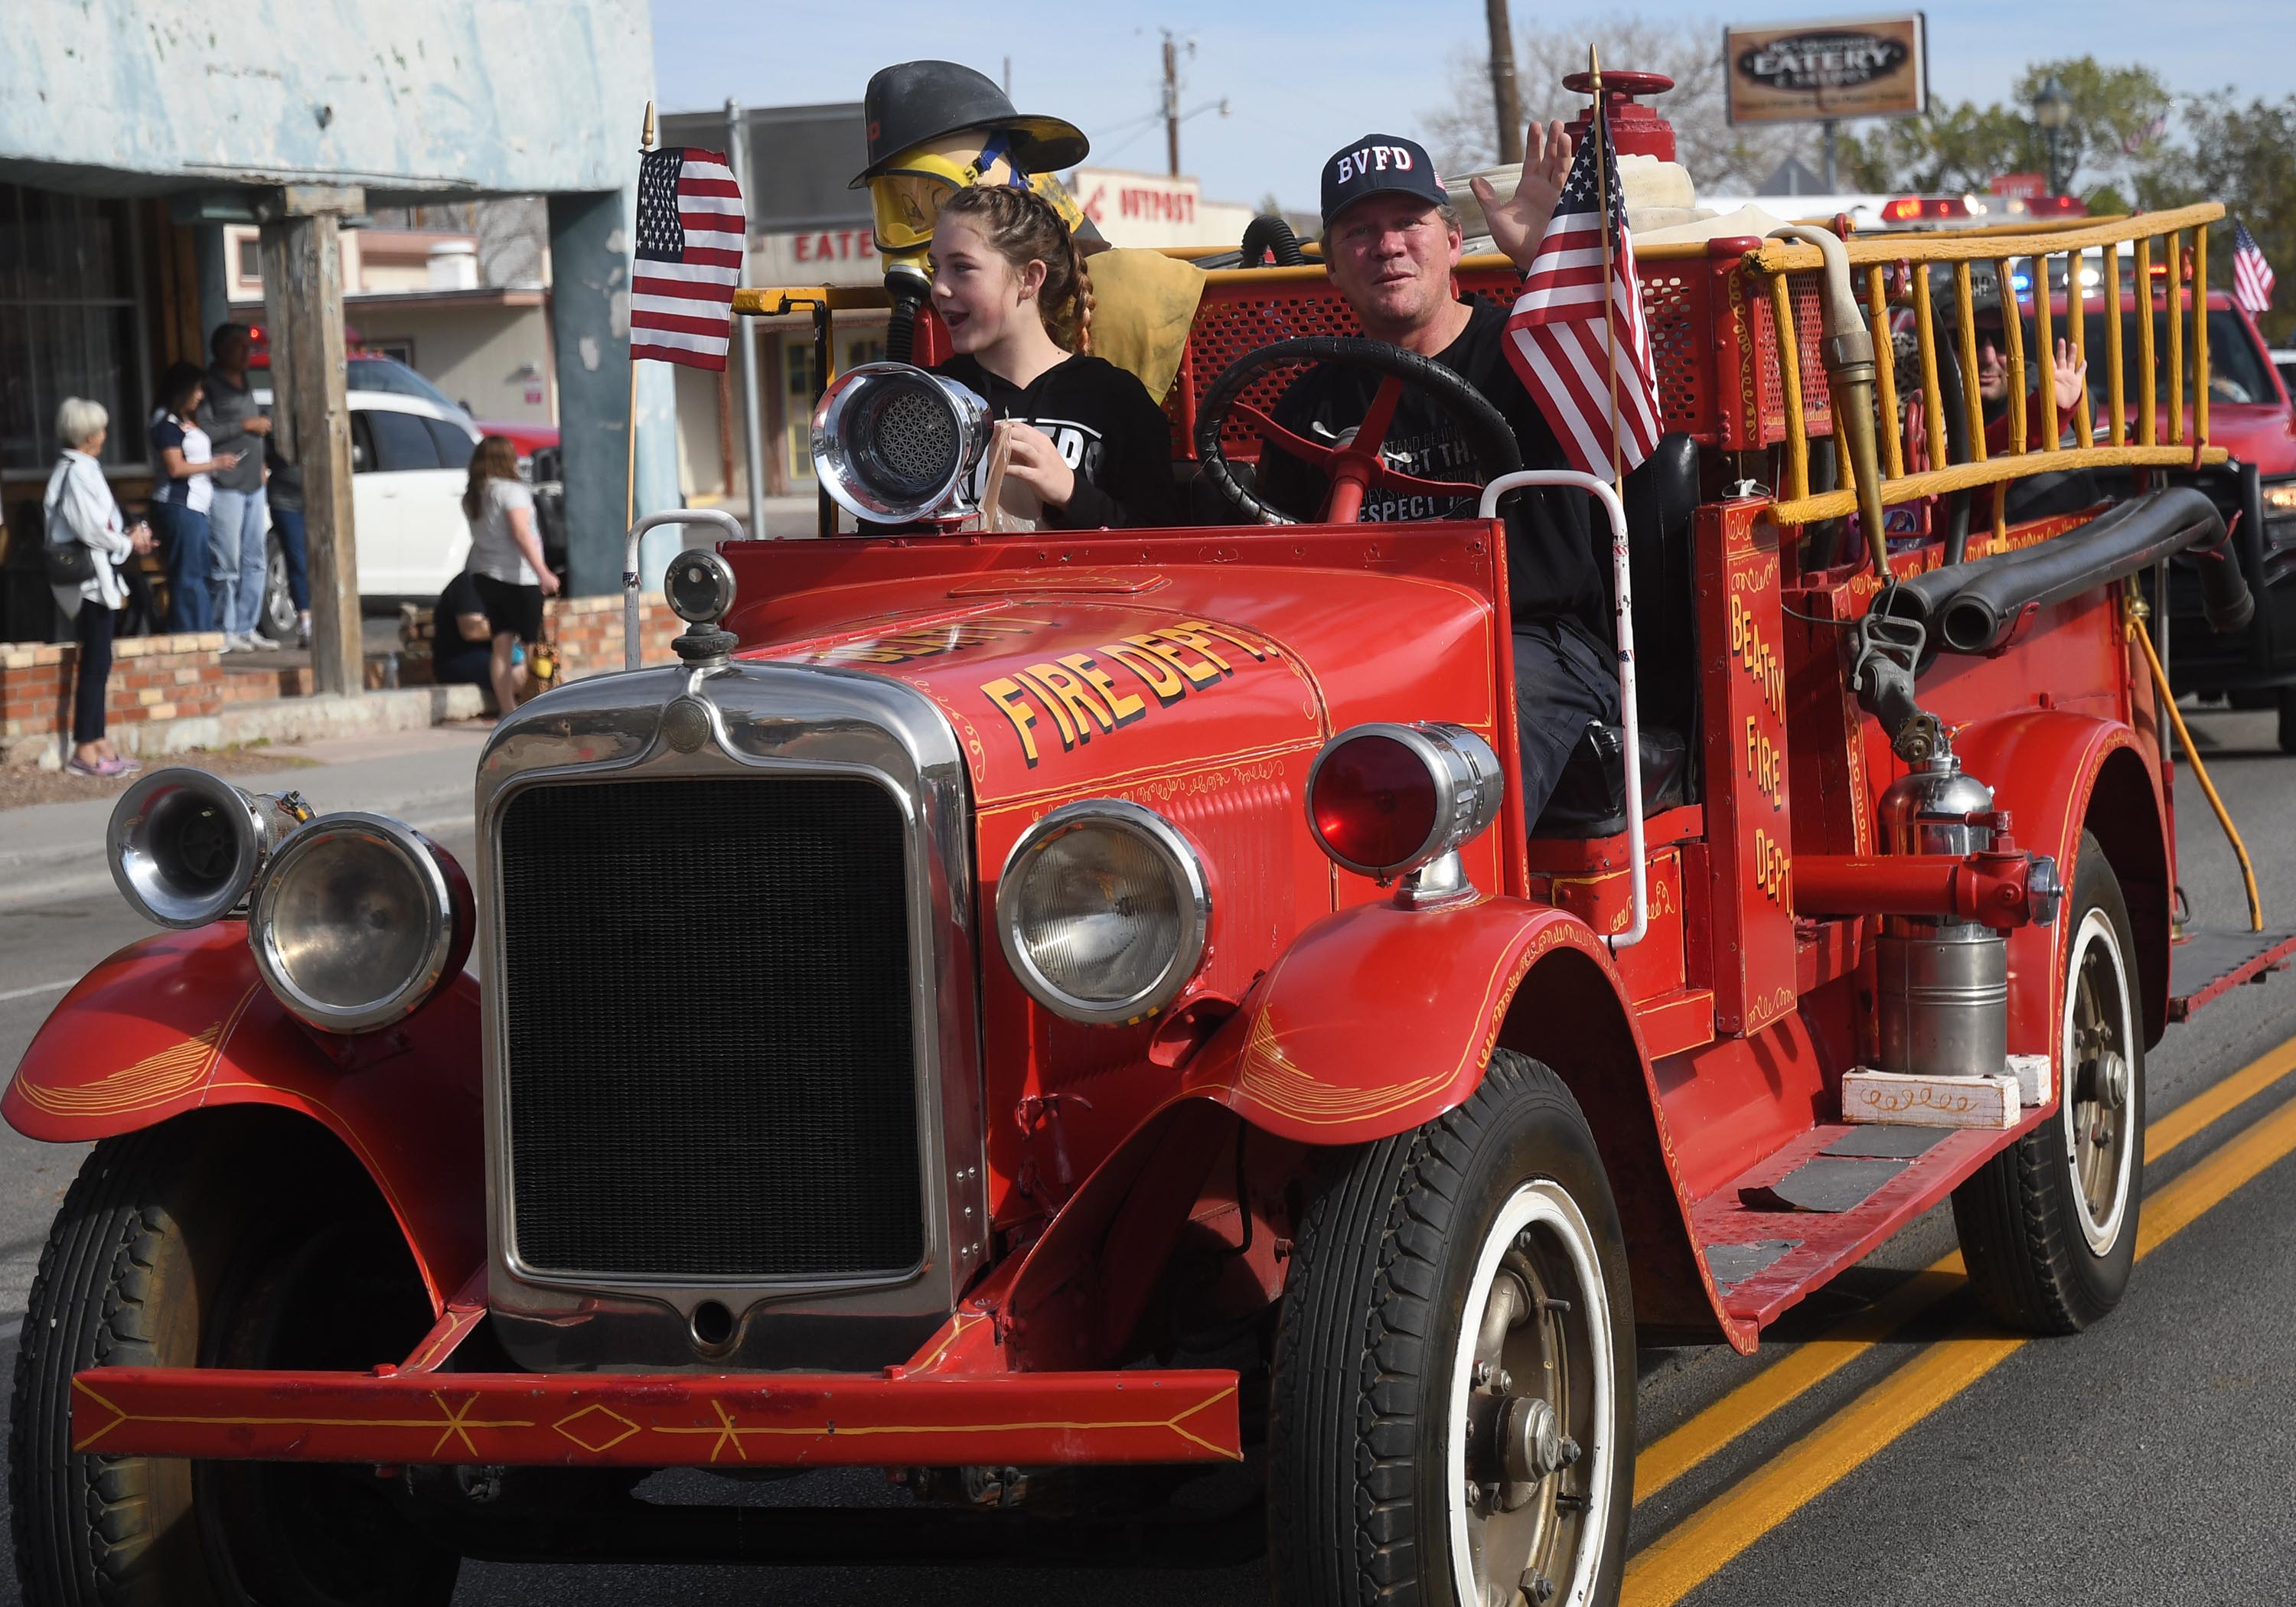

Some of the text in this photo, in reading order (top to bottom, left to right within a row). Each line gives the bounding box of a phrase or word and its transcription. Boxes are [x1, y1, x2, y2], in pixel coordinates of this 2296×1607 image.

[1753, 44, 1893, 75] EATERY
[1337, 146, 1413, 184] BVFD
[1121, 189, 1195, 223] OUTPOST
[795, 231, 875, 261] EATE
[1731, 594, 1785, 725] BEATTY
[980, 621, 1279, 768] FIRE DEPT.
[1746, 715, 1782, 811] FIRE
[1755, 827, 1794, 922] DEPT.
